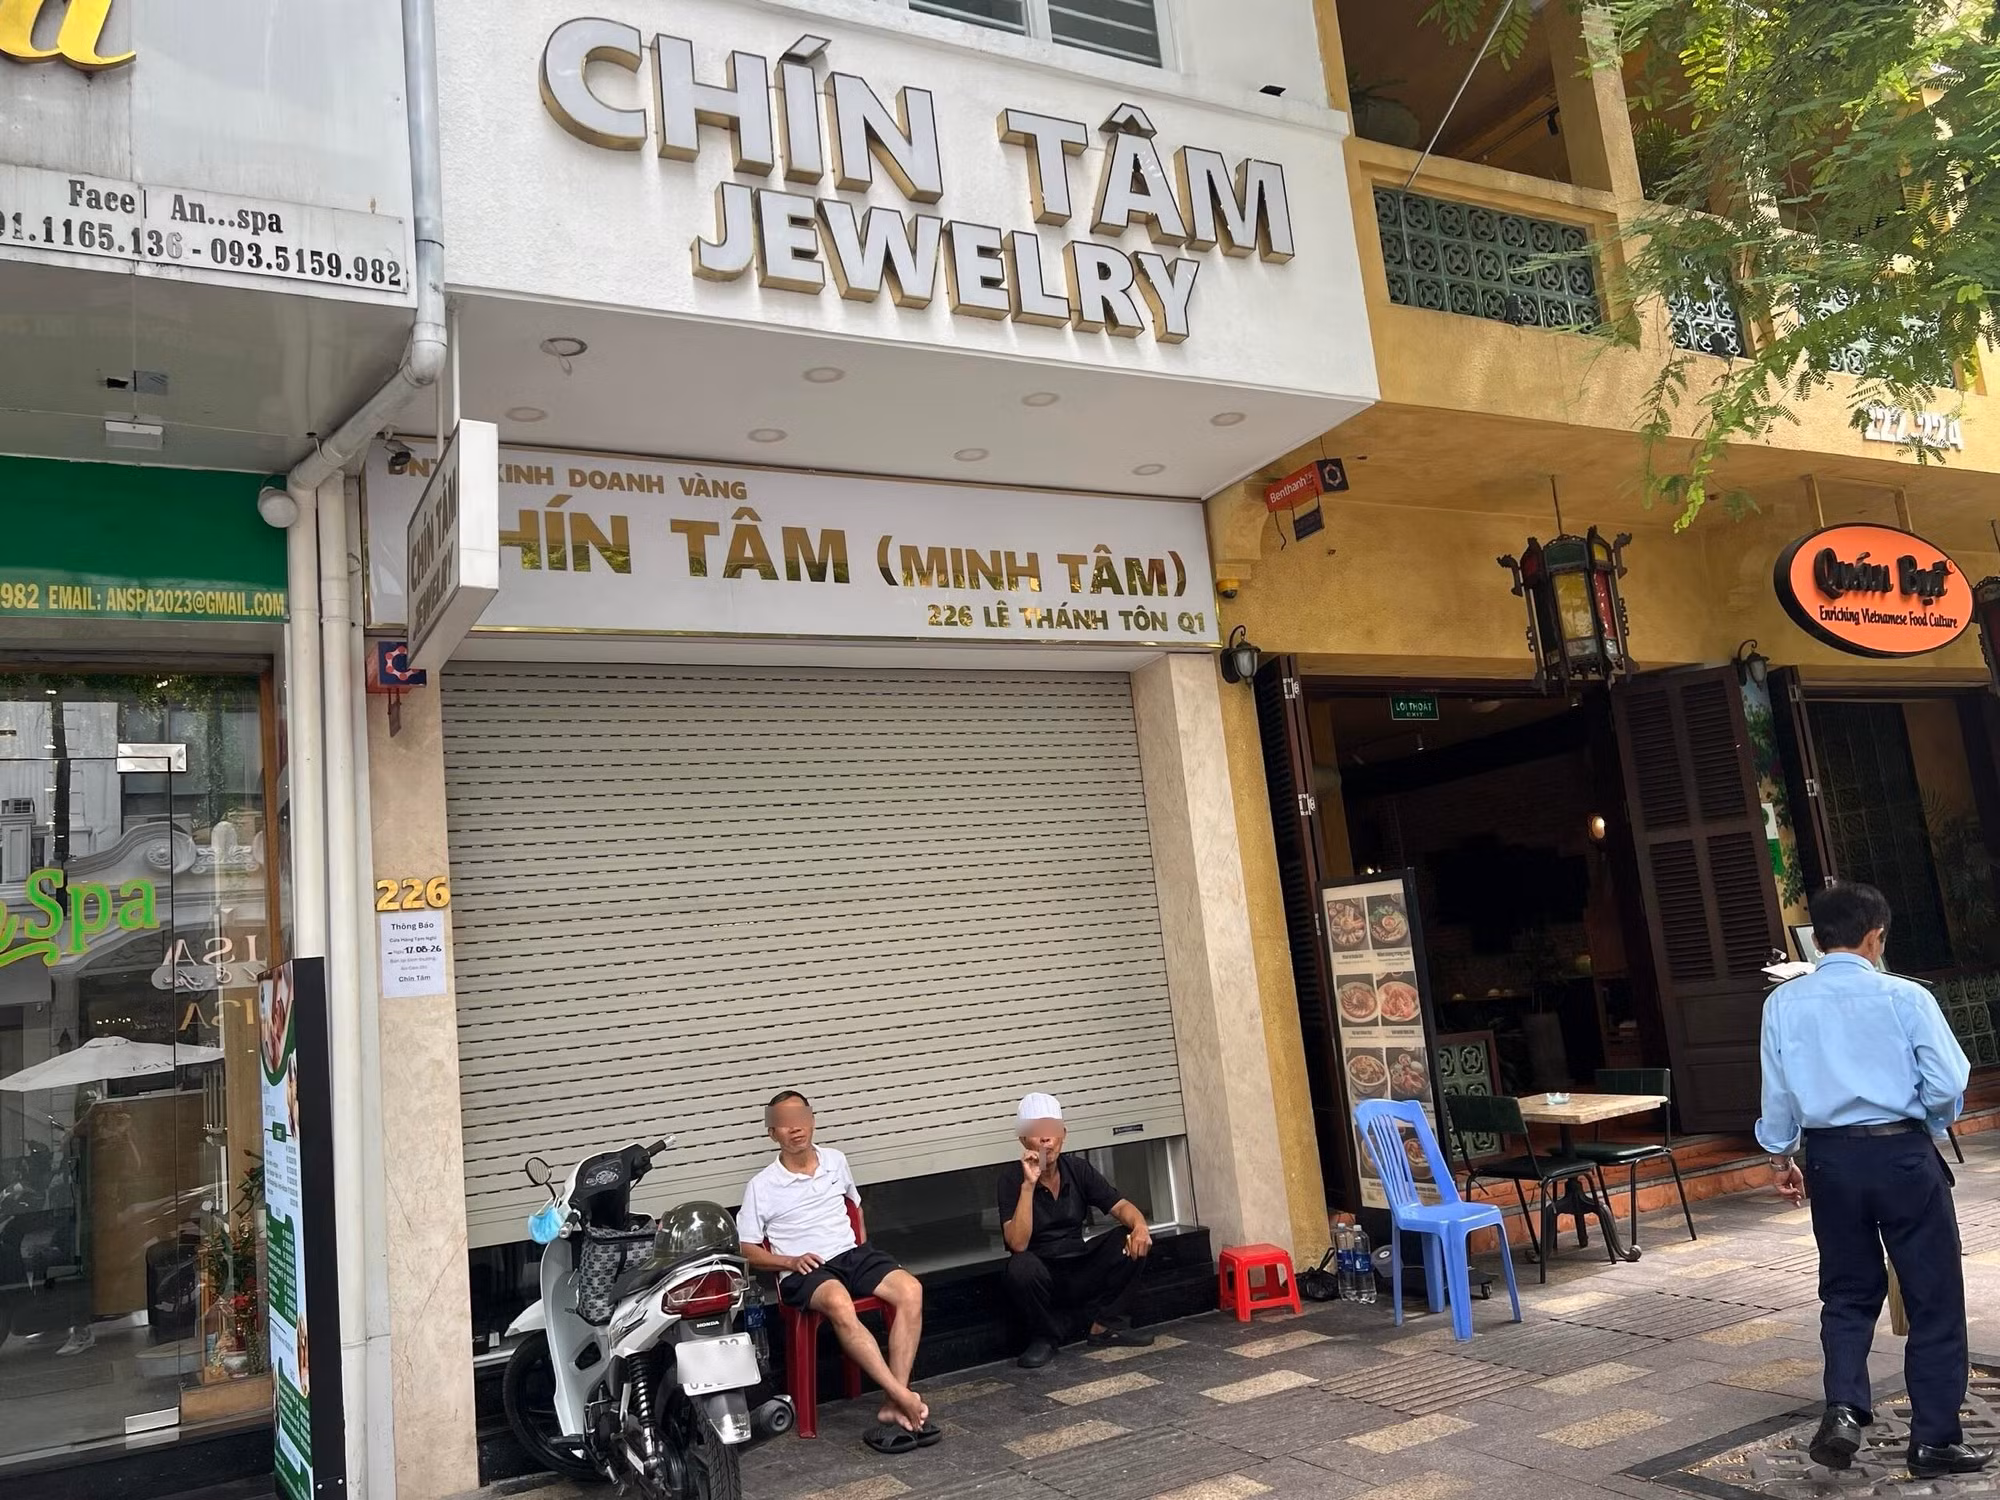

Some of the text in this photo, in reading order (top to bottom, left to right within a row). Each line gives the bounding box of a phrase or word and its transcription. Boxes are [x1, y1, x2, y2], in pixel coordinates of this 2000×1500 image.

[539, 17, 1294, 263] CHÍN TÂM
[68, 180, 135, 214] Face
[0, 211, 183, 259] 1.1165.136
[691, 182, 1200, 343] JEWELRY
[569, 469, 664, 494] DOANH
[678, 472, 747, 500] VÀNG
[499, 494, 1186, 597] HÍN TÂM (MINH TÂM)
[49, 585, 101, 610] EMAIL:
[106, 587, 285, 616] ANSPA2023@GMAIL.COM
[927, 600, 1206, 634] 226 LÊ THÁNH TÔN Q1
[1819, 605, 1958, 628] Enriching Vietnamese Food Culture
[375, 876, 451, 912] 226
[24, 868, 160, 955] Spa
[391, 922, 417, 931] Thông
[697, 1320, 720, 1328] HONDA
